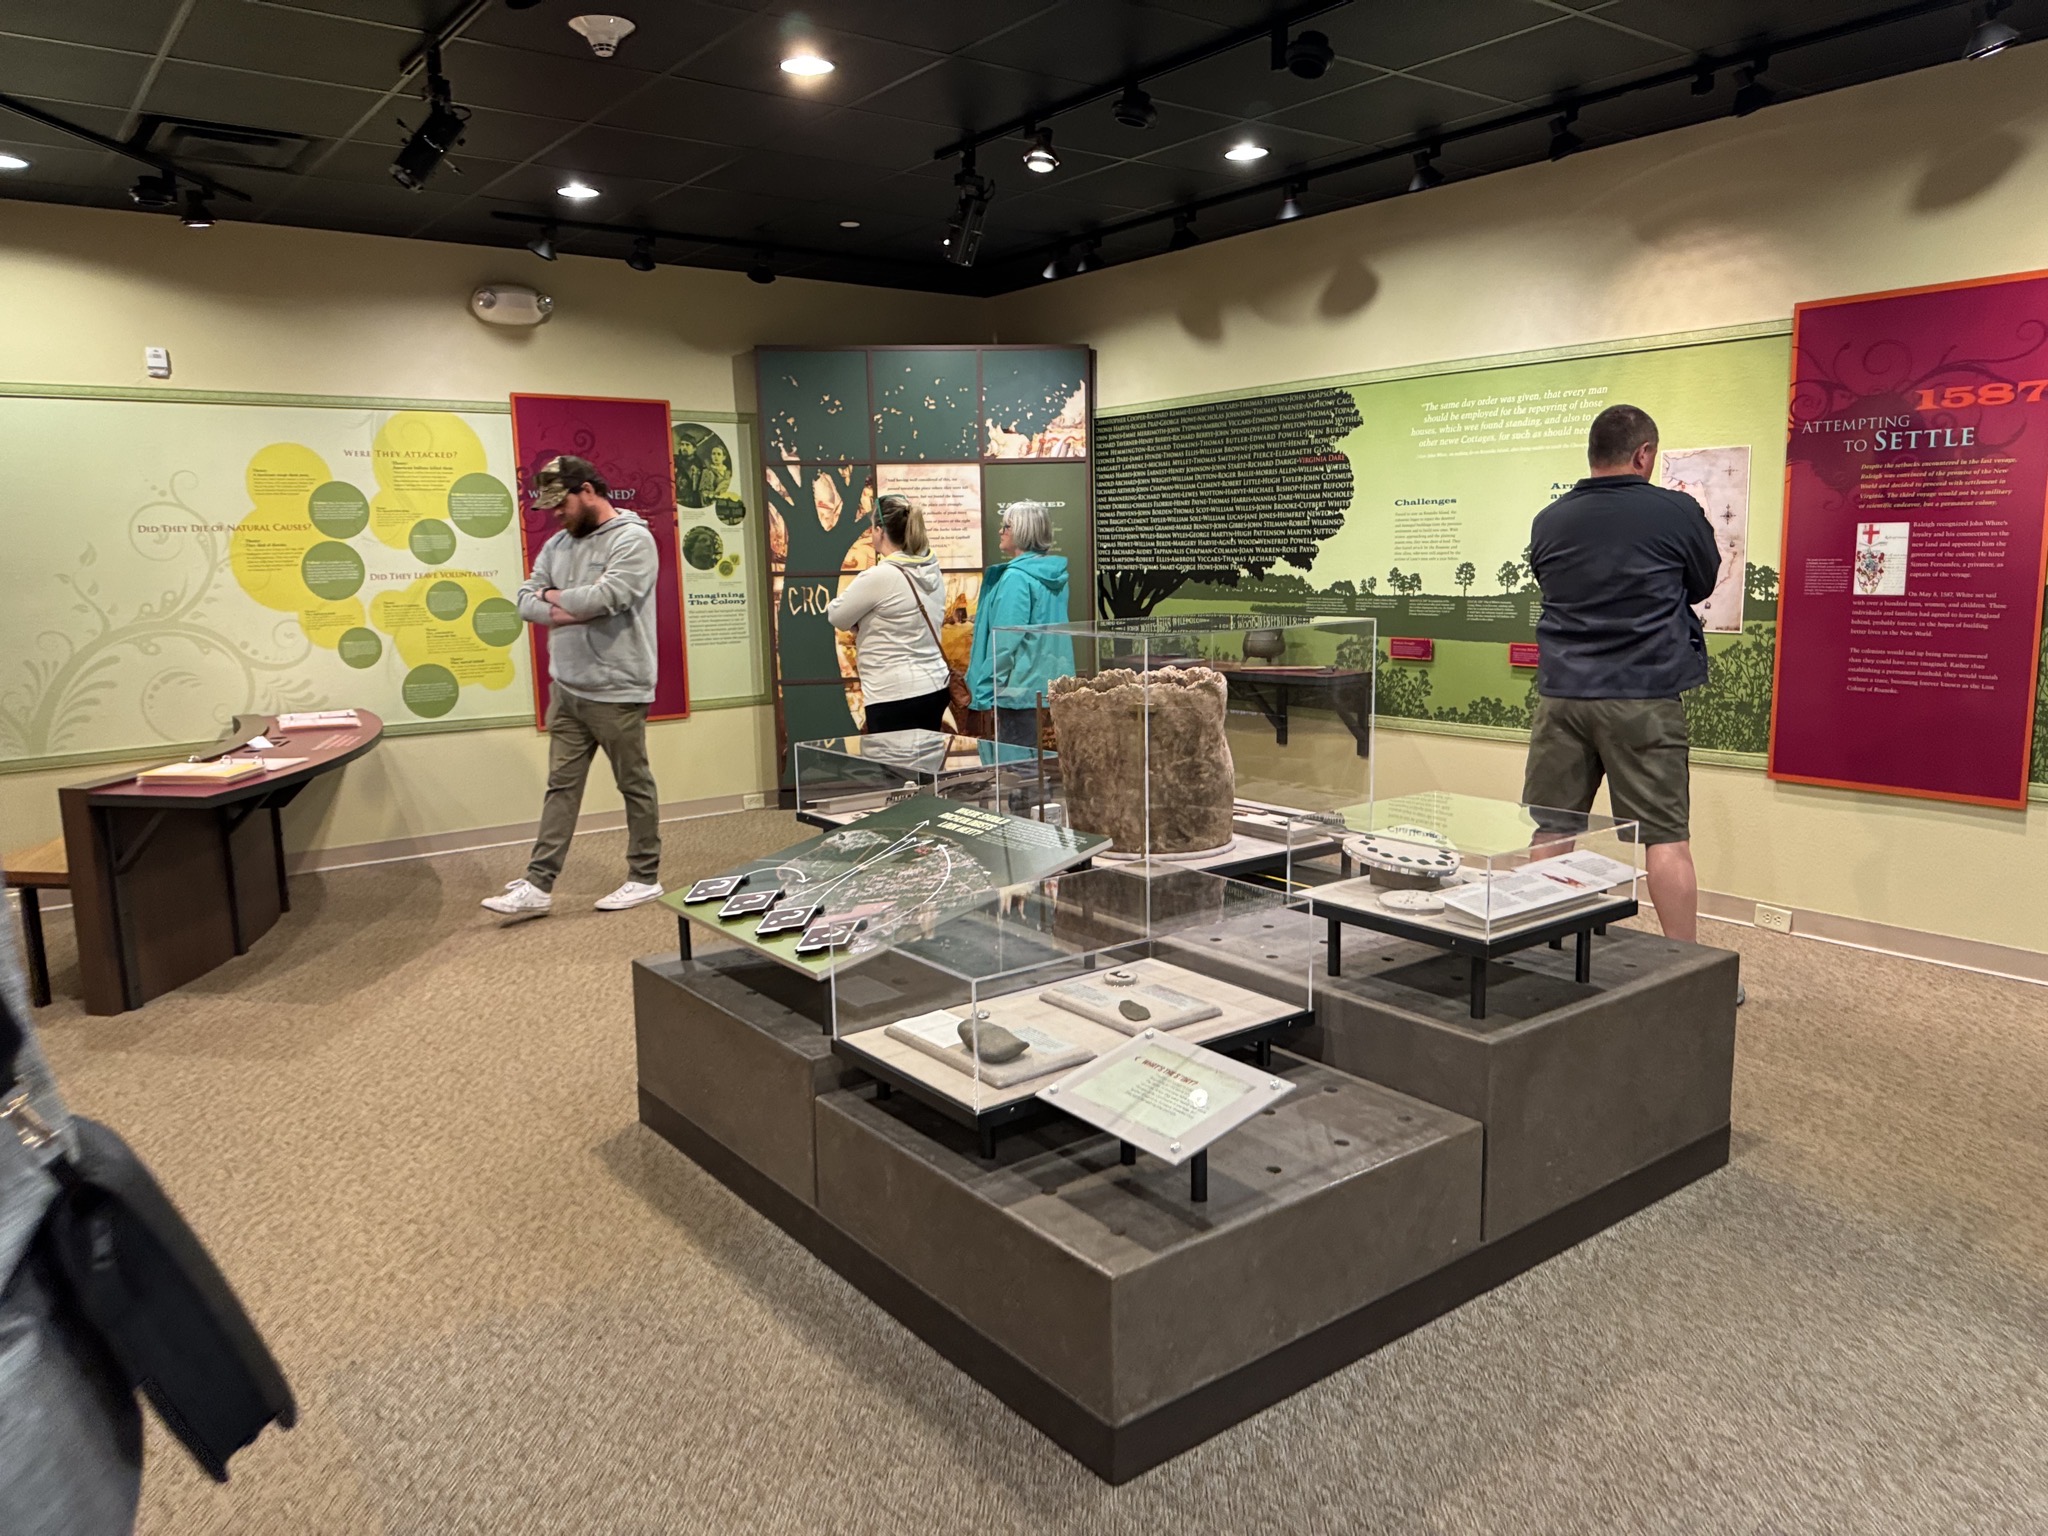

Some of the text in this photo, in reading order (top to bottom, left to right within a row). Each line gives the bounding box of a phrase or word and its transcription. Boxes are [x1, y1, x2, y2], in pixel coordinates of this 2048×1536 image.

[1461, 397, 1476, 411] day
[1477, 395, 1498, 407] order
[1499, 397, 1516, 405] was
[1516, 391, 1542, 406] given,
[1543, 389, 1561, 401] that
[1562, 391, 1586, 402] every
[1915, 380, 2048, 410] 1587
[1424, 412, 1449, 423] should
[1461, 408, 1499, 423] employed
[1499, 406, 1512, 420] for
[1512, 405, 1527, 416] the
[1527, 402, 1568, 418] repayring
[1579, 399, 1603, 411] those
[1411, 424, 1436, 439] houses,
[1439, 422, 1462, 434] which
[1480, 419, 1504, 434] found
[1505, 416, 1543, 432] standing,
[1544, 415, 1561, 426] and
[1562, 413, 1581, 424] also
[1802, 415, 1910, 434] ATTEMPTING
[1419, 437, 1438, 449] other
[1439, 439, 1459, 447] newe
[1460, 433, 1497, 448] Cottages,
[1498, 431, 1510, 445] for
[1511, 430, 1532, 441] such
[1543, 427, 1572, 439] should
[1843, 427, 1975, 452] TO SETTLE
[343, 449, 458, 459] WERE THEY ATTACKED?
[1395, 498, 1457, 506] Challenges
[138, 523, 312, 533] DID THEY DIE OF NATURAL CAUSES?
[1311, 518, 1345, 526] WILKINSON
[370, 570, 499, 581] DID THEY LEAVE VOLUNTARILY?
